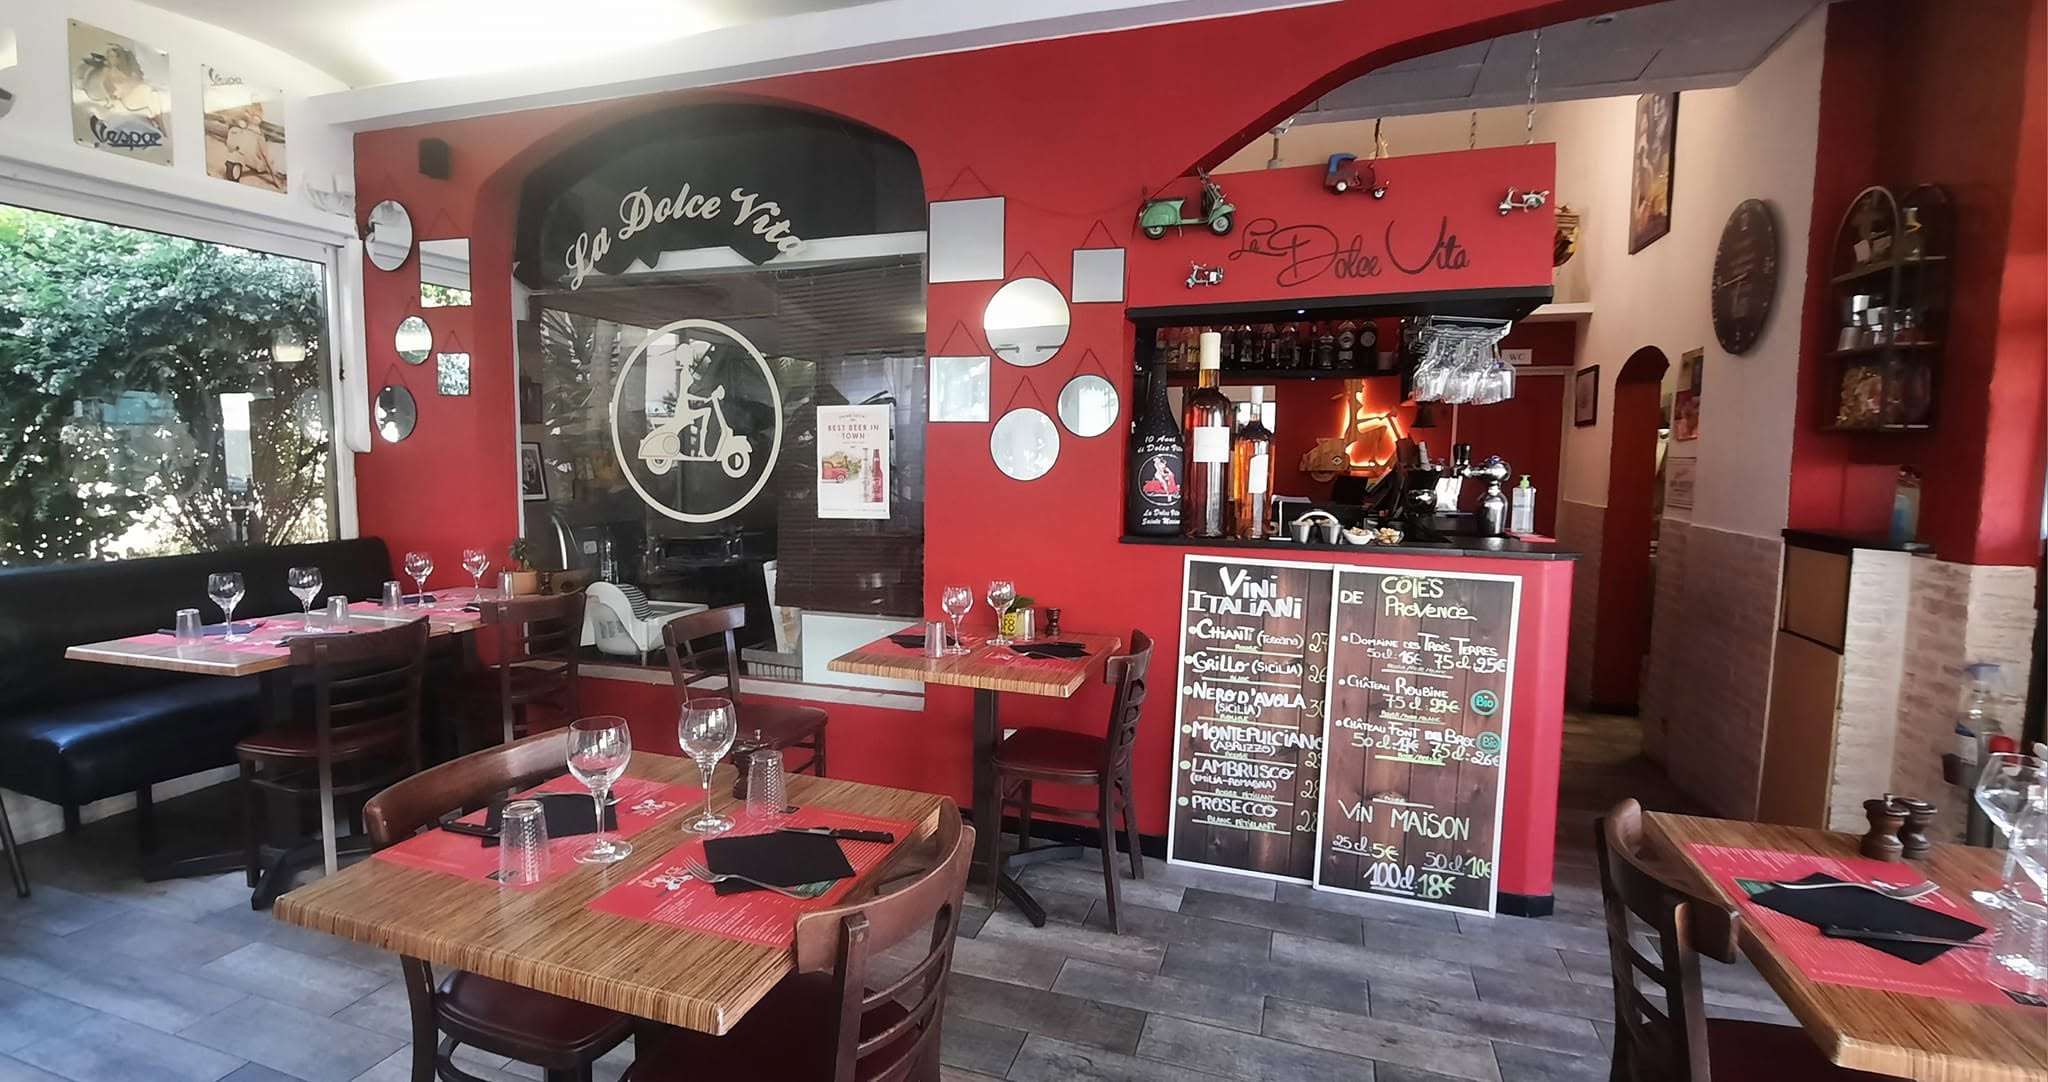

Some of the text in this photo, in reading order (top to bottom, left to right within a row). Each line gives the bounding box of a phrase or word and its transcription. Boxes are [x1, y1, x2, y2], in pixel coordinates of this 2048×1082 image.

[89, 114, 164, 151] Vespa
[566, 182, 808, 291] La Dolce Vita
[1228, 215, 1471, 288] La Dolce Vita
[1509, 352, 1526, 361] WC
[828, 424, 846, 432] BEST
[848, 424, 867, 432] BEER
[842, 432, 866, 440] TOWN
[1340, 590, 1365, 605] DE
[1367, 647, 1381, 659] 50
[1434, 653, 1455, 670] 75
[1192, 681, 1237, 703] NERO
[1383, 693, 1406, 709] 75
[1475, 695, 1494, 709] Bio
[1351, 732, 1374, 748] 50
[1429, 740, 1451, 759] 75
[1191, 794, 1279, 818] PROSECCO
[1332, 833, 1353, 849] 25
[1423, 851, 1448, 869] 50
